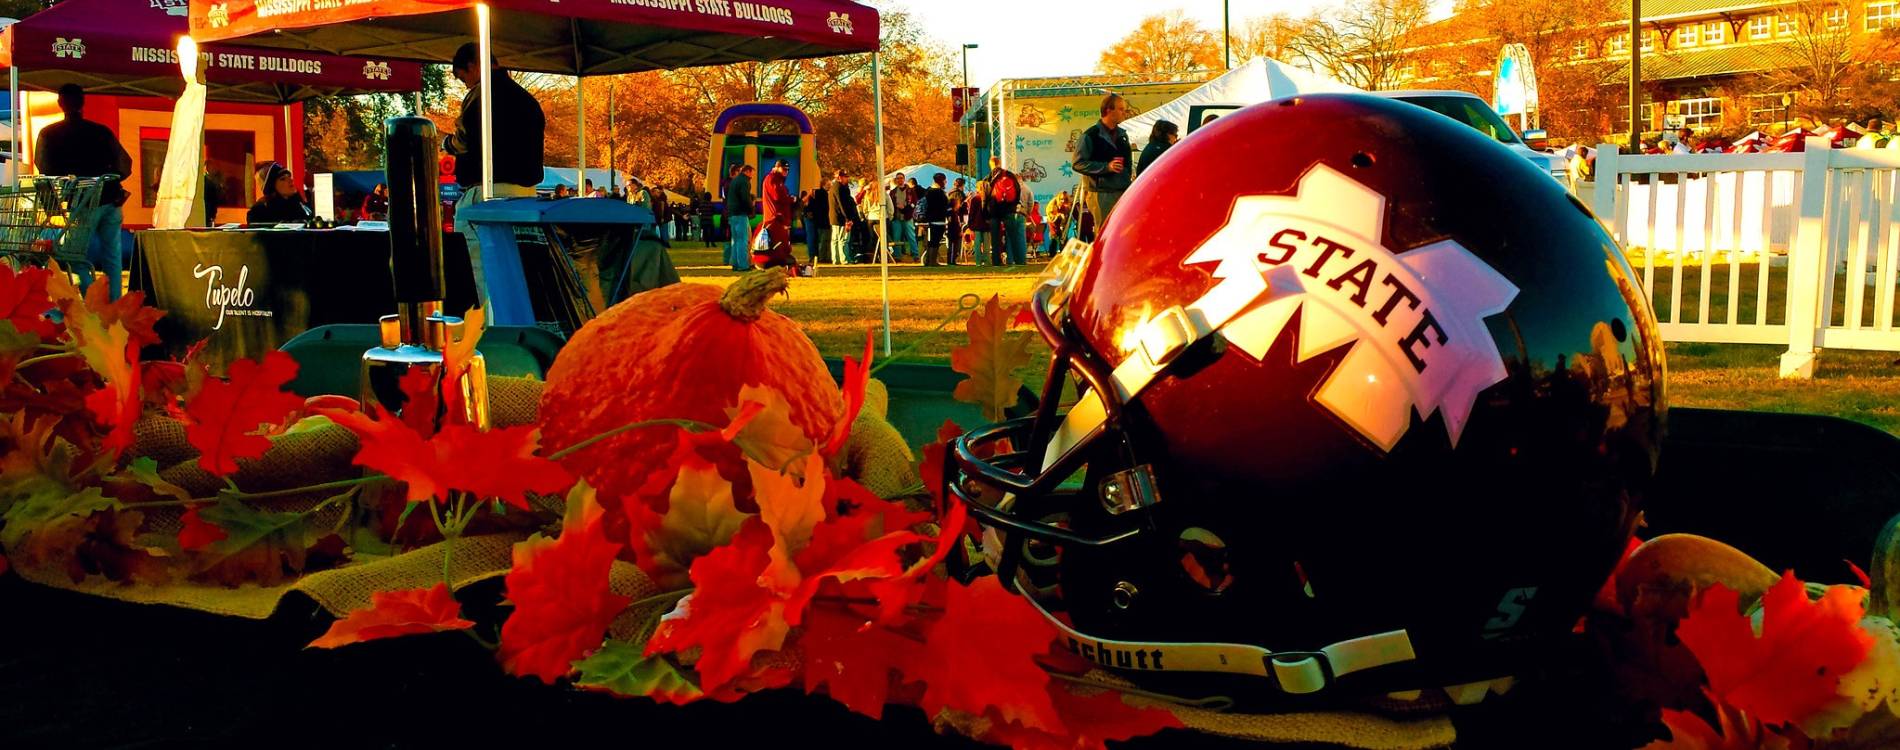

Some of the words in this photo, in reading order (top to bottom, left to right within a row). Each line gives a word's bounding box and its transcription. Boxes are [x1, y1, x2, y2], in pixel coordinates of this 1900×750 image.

[695, 0, 732, 17] STATE
[733, 1, 794, 26] BULLDOGS
[218, 53, 255, 70] STATE
[259, 56, 322, 74] BULLDOGS
[193, 263, 254, 330] Tupelo
[1257, 228, 1449, 374] STATE
[1068, 636, 1163, 670] schutt
